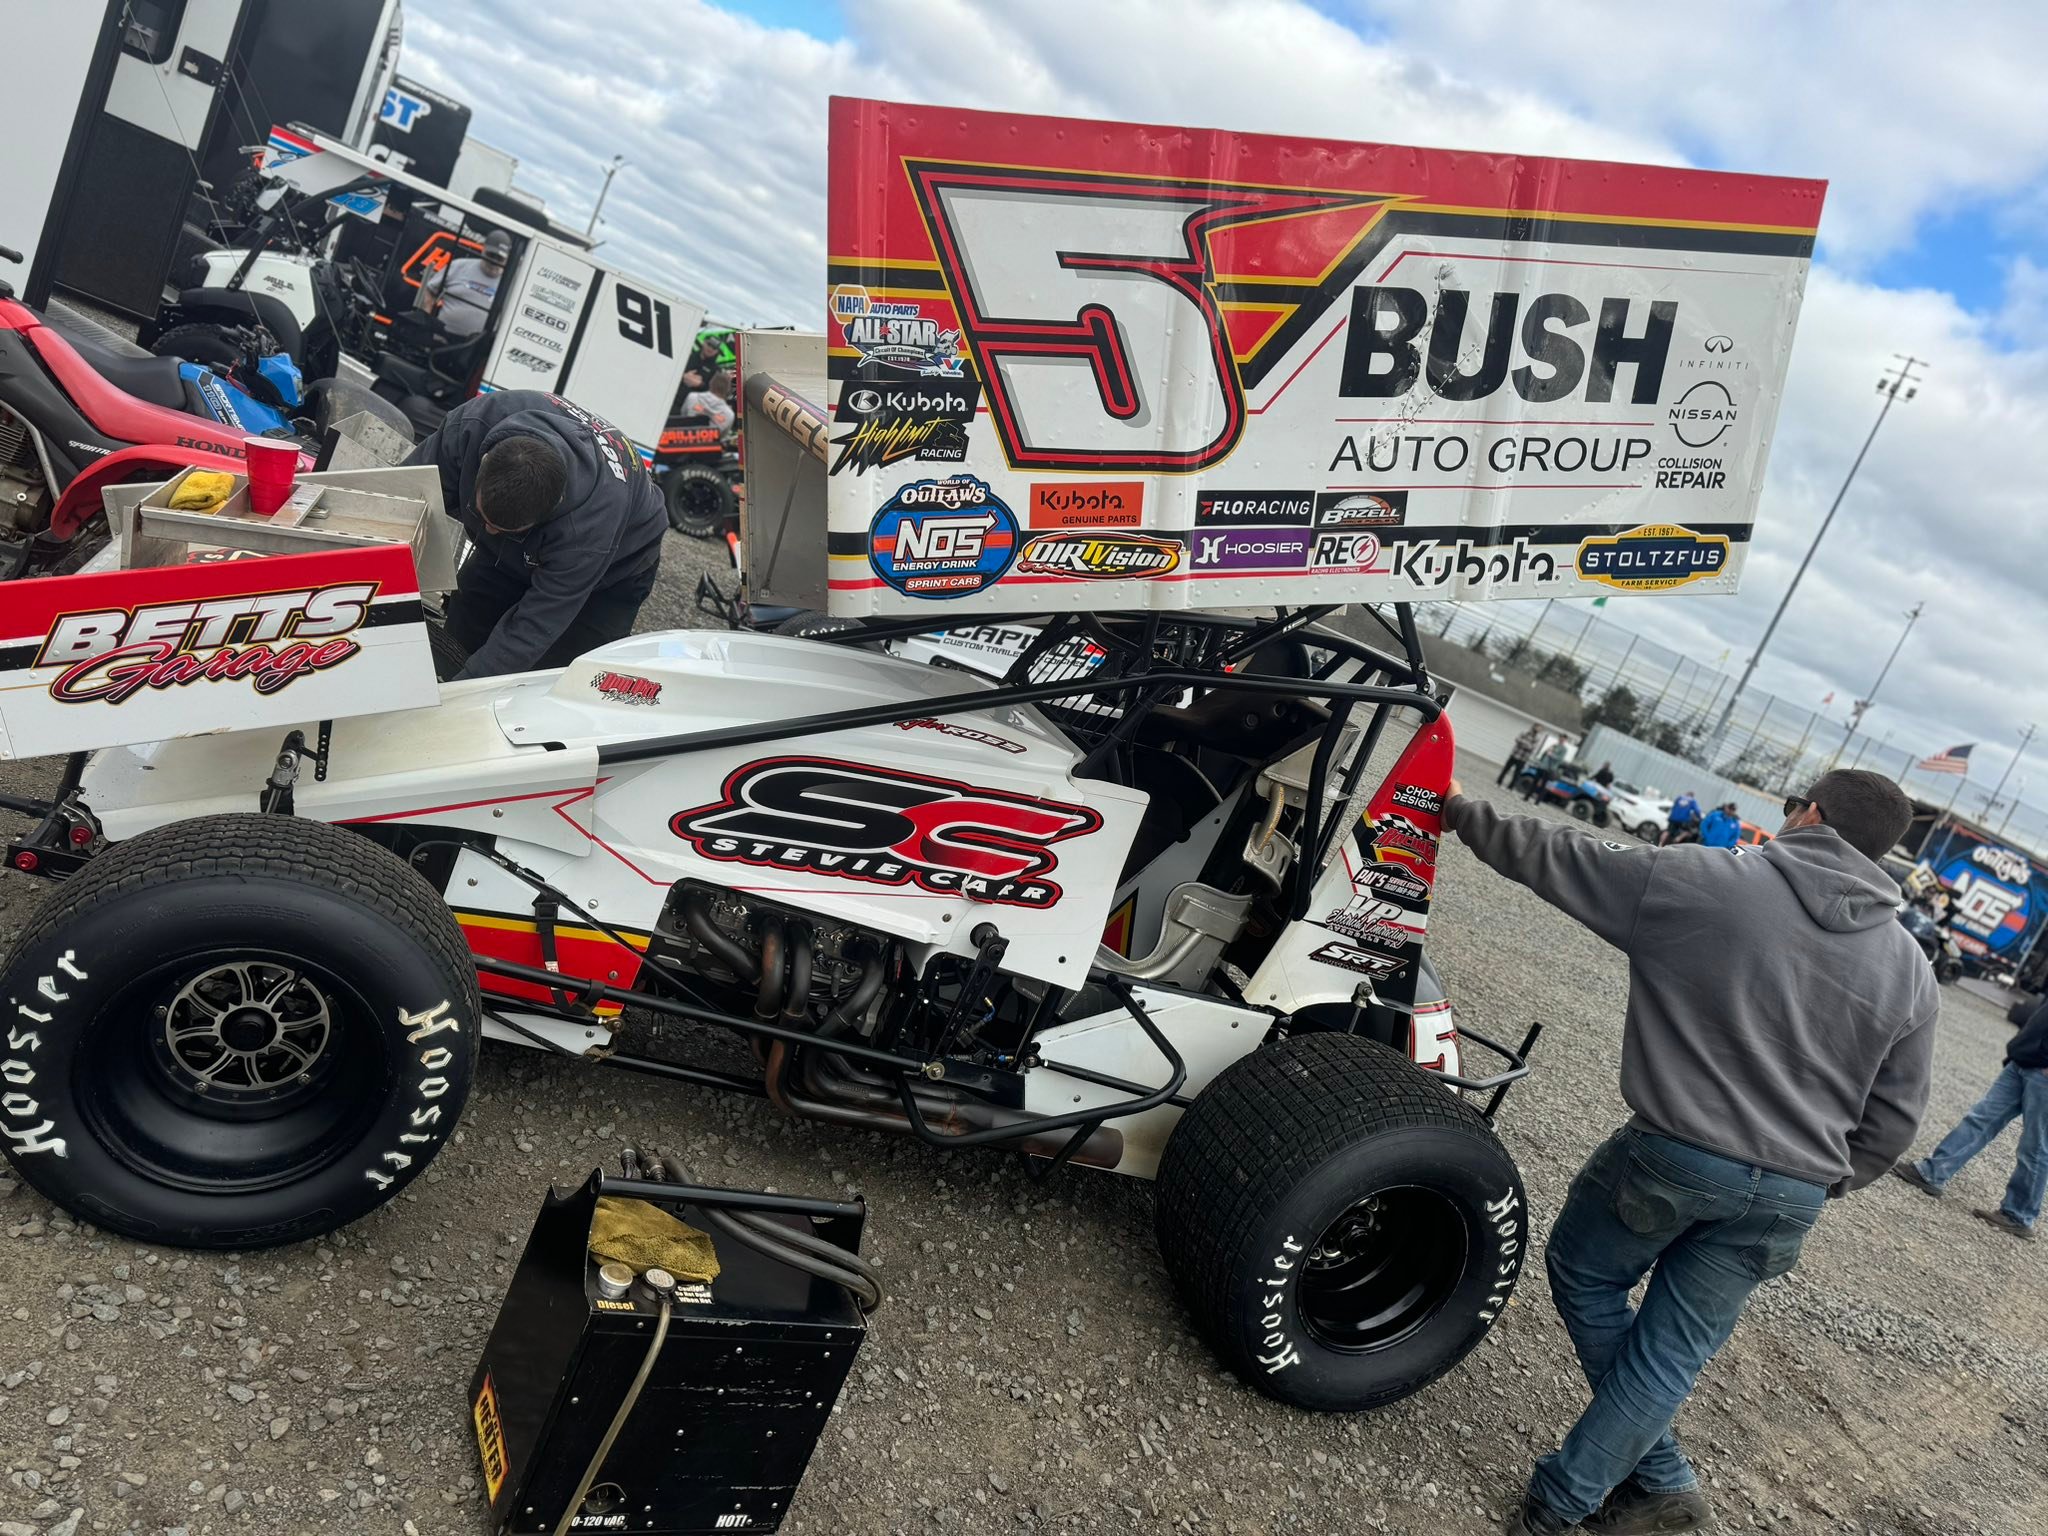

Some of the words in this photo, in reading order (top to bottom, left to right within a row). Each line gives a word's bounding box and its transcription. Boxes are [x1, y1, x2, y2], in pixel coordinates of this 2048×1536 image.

[838, 296, 865, 314] NAPA
[869, 303, 891, 314] AUTO
[892, 305, 919, 316] PARTS
[616, 282, 673, 359] 91
[908, 165, 1246, 473] 5
[850, 318, 885, 344] ALL
[887, 320, 936, 346] STAR
[1338, 285, 1679, 405] BUSH
[1680, 360, 1749, 370] INFINITI
[887, 391, 966, 412] Kubota
[1669, 409, 1738, 420] NISSAN
[176, 436, 246, 460] HOND
[921, 448, 962, 459] RACING
[1329, 434, 1469, 472] AUTO
[1488, 437, 1652, 473] GROUP
[1658, 458, 1722, 469] COLLISION
[1655, 471, 1726, 489] REPAIR
[1041, 490, 1125, 511] Kubota
[1062, 515, 1104, 525] GENUINE
[1107, 514, 1137, 524] PARTS
[1320, 508, 1401, 525] BAZELL
[894, 511, 998, 560] NOS
[1659, 527, 1675, 536] 1967
[1225, 543, 1303, 555] HOOSIER
[1586, 550, 1720, 568] STOLTZFUS
[893, 561, 940, 571] ENERGY
[942, 559, 978, 570] DRINK
[1393, 541, 1554, 587] Kubota
[907, 578, 948, 589] SPRINT
[950, 575, 980, 587] CARS
[36, 582, 378, 668] BETTS
[943, 638, 984, 650] CUSTOM
[50, 640, 361, 705] Garage
[943, 726, 1024, 753] ROSS
[1393, 791, 1441, 812] DESIGNS
[1406, 785, 1437, 800] CHOP
[1377, 827, 1436, 864] RACING
[711, 838, 902, 877] STEVIE
[1354, 868, 1389, 888] PAT'S
[1343, 894, 1403, 922] VP
[1320, 944, 1397, 970] SRT
[0, 949, 89, 1159] Hoosier
[365, 999, 460, 1191] Hoosier
[1478, 1186, 1520, 1325] Hoosier
[596, 1300, 635, 1311] Diesel
[1257, 1235, 1303, 1375] Hoosier
[480, 1393, 503, 1485] HEATER
[715, 1514, 749, 1528] HOT!
